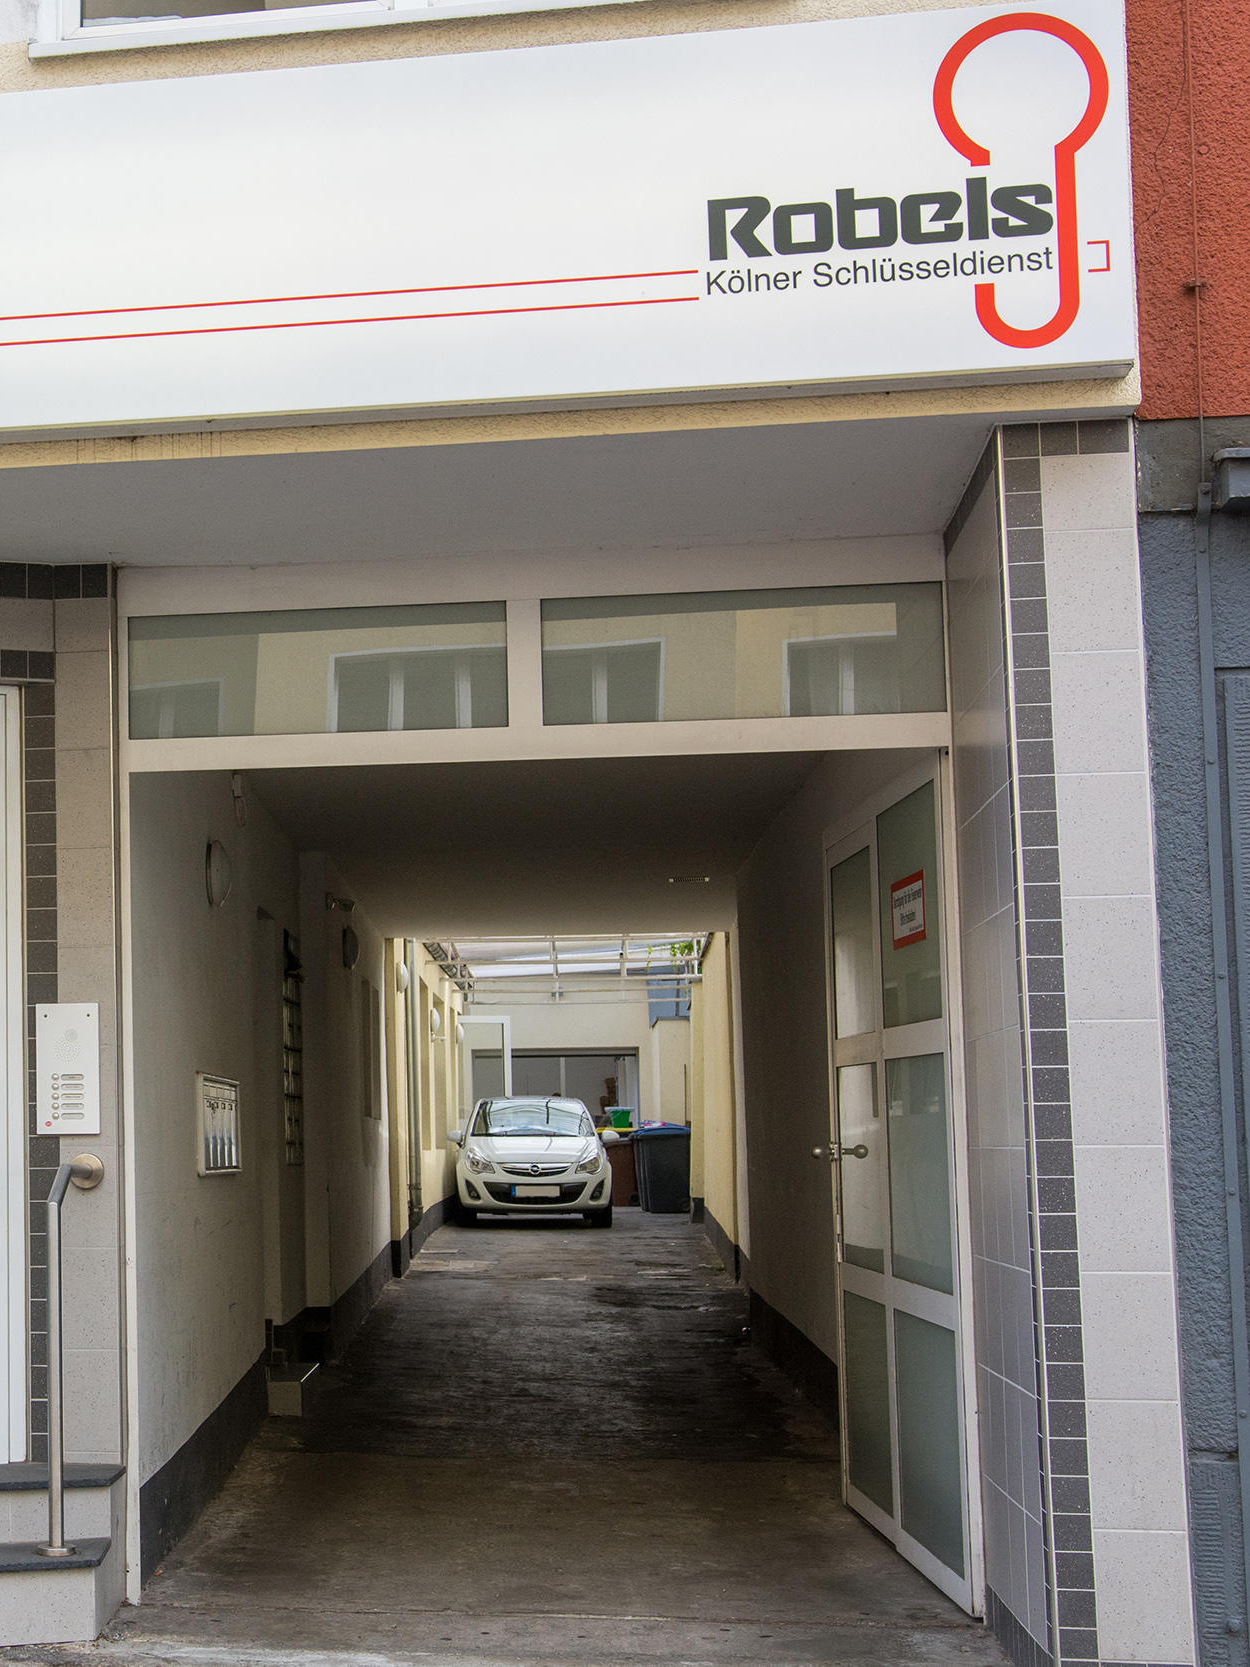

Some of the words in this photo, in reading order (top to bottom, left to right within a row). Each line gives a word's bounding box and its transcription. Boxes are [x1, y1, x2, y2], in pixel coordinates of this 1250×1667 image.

[707, 176, 1054, 261] Robels
[706, 267, 803, 296] Kölner
[812, 246, 1054, 289] Schlüsseldienst
